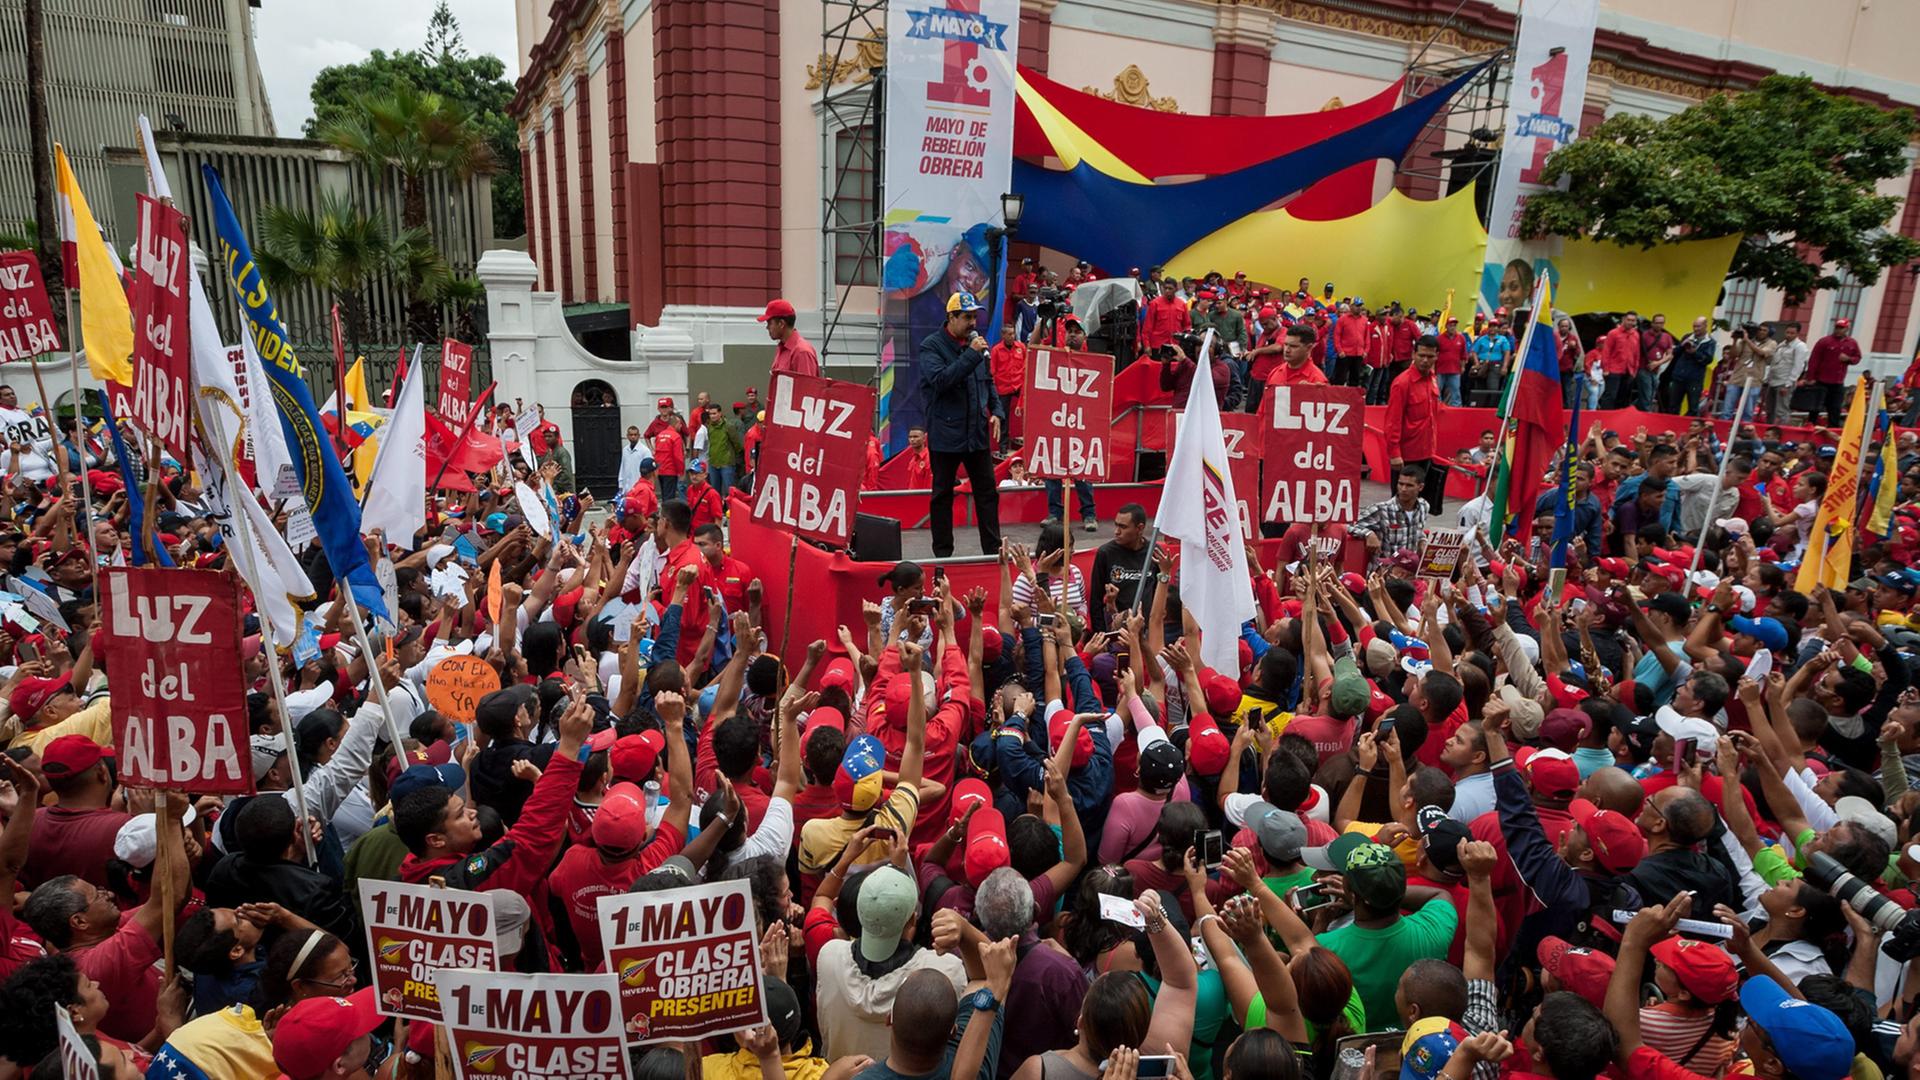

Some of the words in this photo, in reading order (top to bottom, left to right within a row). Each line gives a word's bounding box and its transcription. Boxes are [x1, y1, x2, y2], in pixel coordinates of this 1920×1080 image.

[930, 13, 986, 39] MAYO
[925, 116, 965, 135] MAYO
[968, 120, 988, 138] DE
[921, 136, 986, 157] REBELIÓN
[918, 155, 984, 179] OBRERA
[4, 297, 33, 318] del
[0, 318, 60, 362] ALBA
[146, 300, 173, 357] del
[447, 373, 459, 391] del
[134, 356, 186, 452] ALBA
[440, 392, 467, 424] ALBA
[1051, 402, 1086, 430] del
[787, 442, 824, 476] del
[1028, 436, 1105, 476] ALBA
[1293, 441, 1335, 471] del
[753, 473, 847, 537] ALBA
[1264, 478, 1354, 523] ALBA
[141, 658, 195, 701] del
[441, 660, 467, 672] CON
[471, 661, 487, 676] EL
[450, 690, 475, 711] YA
[122, 714, 242, 783] ALBA
[371, 891, 387, 924] 1
[387, 906, 398, 915] DE
[398, 893, 488, 937] MAYO
[610, 906, 629, 945] 1
[629, 922, 640, 932] DE
[641, 892, 745, 943] MAYO
[380, 963, 409, 974] INVEPAL
[408, 938, 492, 970] CLASE
[655, 939, 751, 978] CLASE
[621, 986, 656, 997] INVEPAL
[659, 965, 755, 999] OBRERA
[451, 985, 471, 1026] 1
[471, 1004, 485, 1015] DE
[486, 988, 612, 1034] MAYO
[650, 986, 754, 1018] PRESENTE!
[506, 1042, 619, 1075] CLASE
